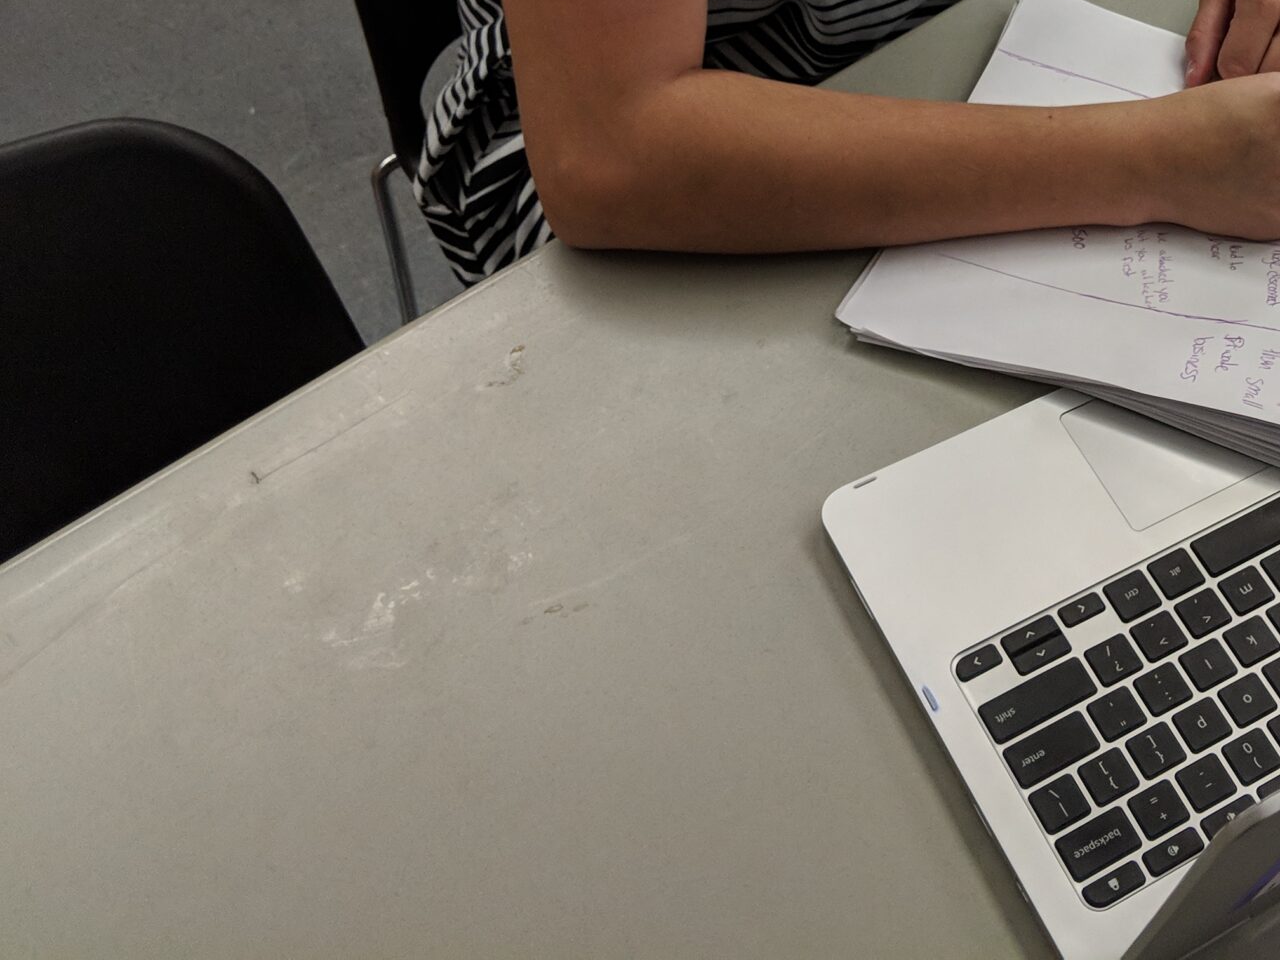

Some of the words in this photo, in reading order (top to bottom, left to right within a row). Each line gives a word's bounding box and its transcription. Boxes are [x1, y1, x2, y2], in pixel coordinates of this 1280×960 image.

[1180, 336, 1214, 382] business
[1170, 566, 1181, 577] alt
[1125, 588, 1139, 600] ctrl
[996, 707, 1016, 724] shift
[1021, 749, 1045, 767] enter
[1074, 828, 1120, 858] backspace
